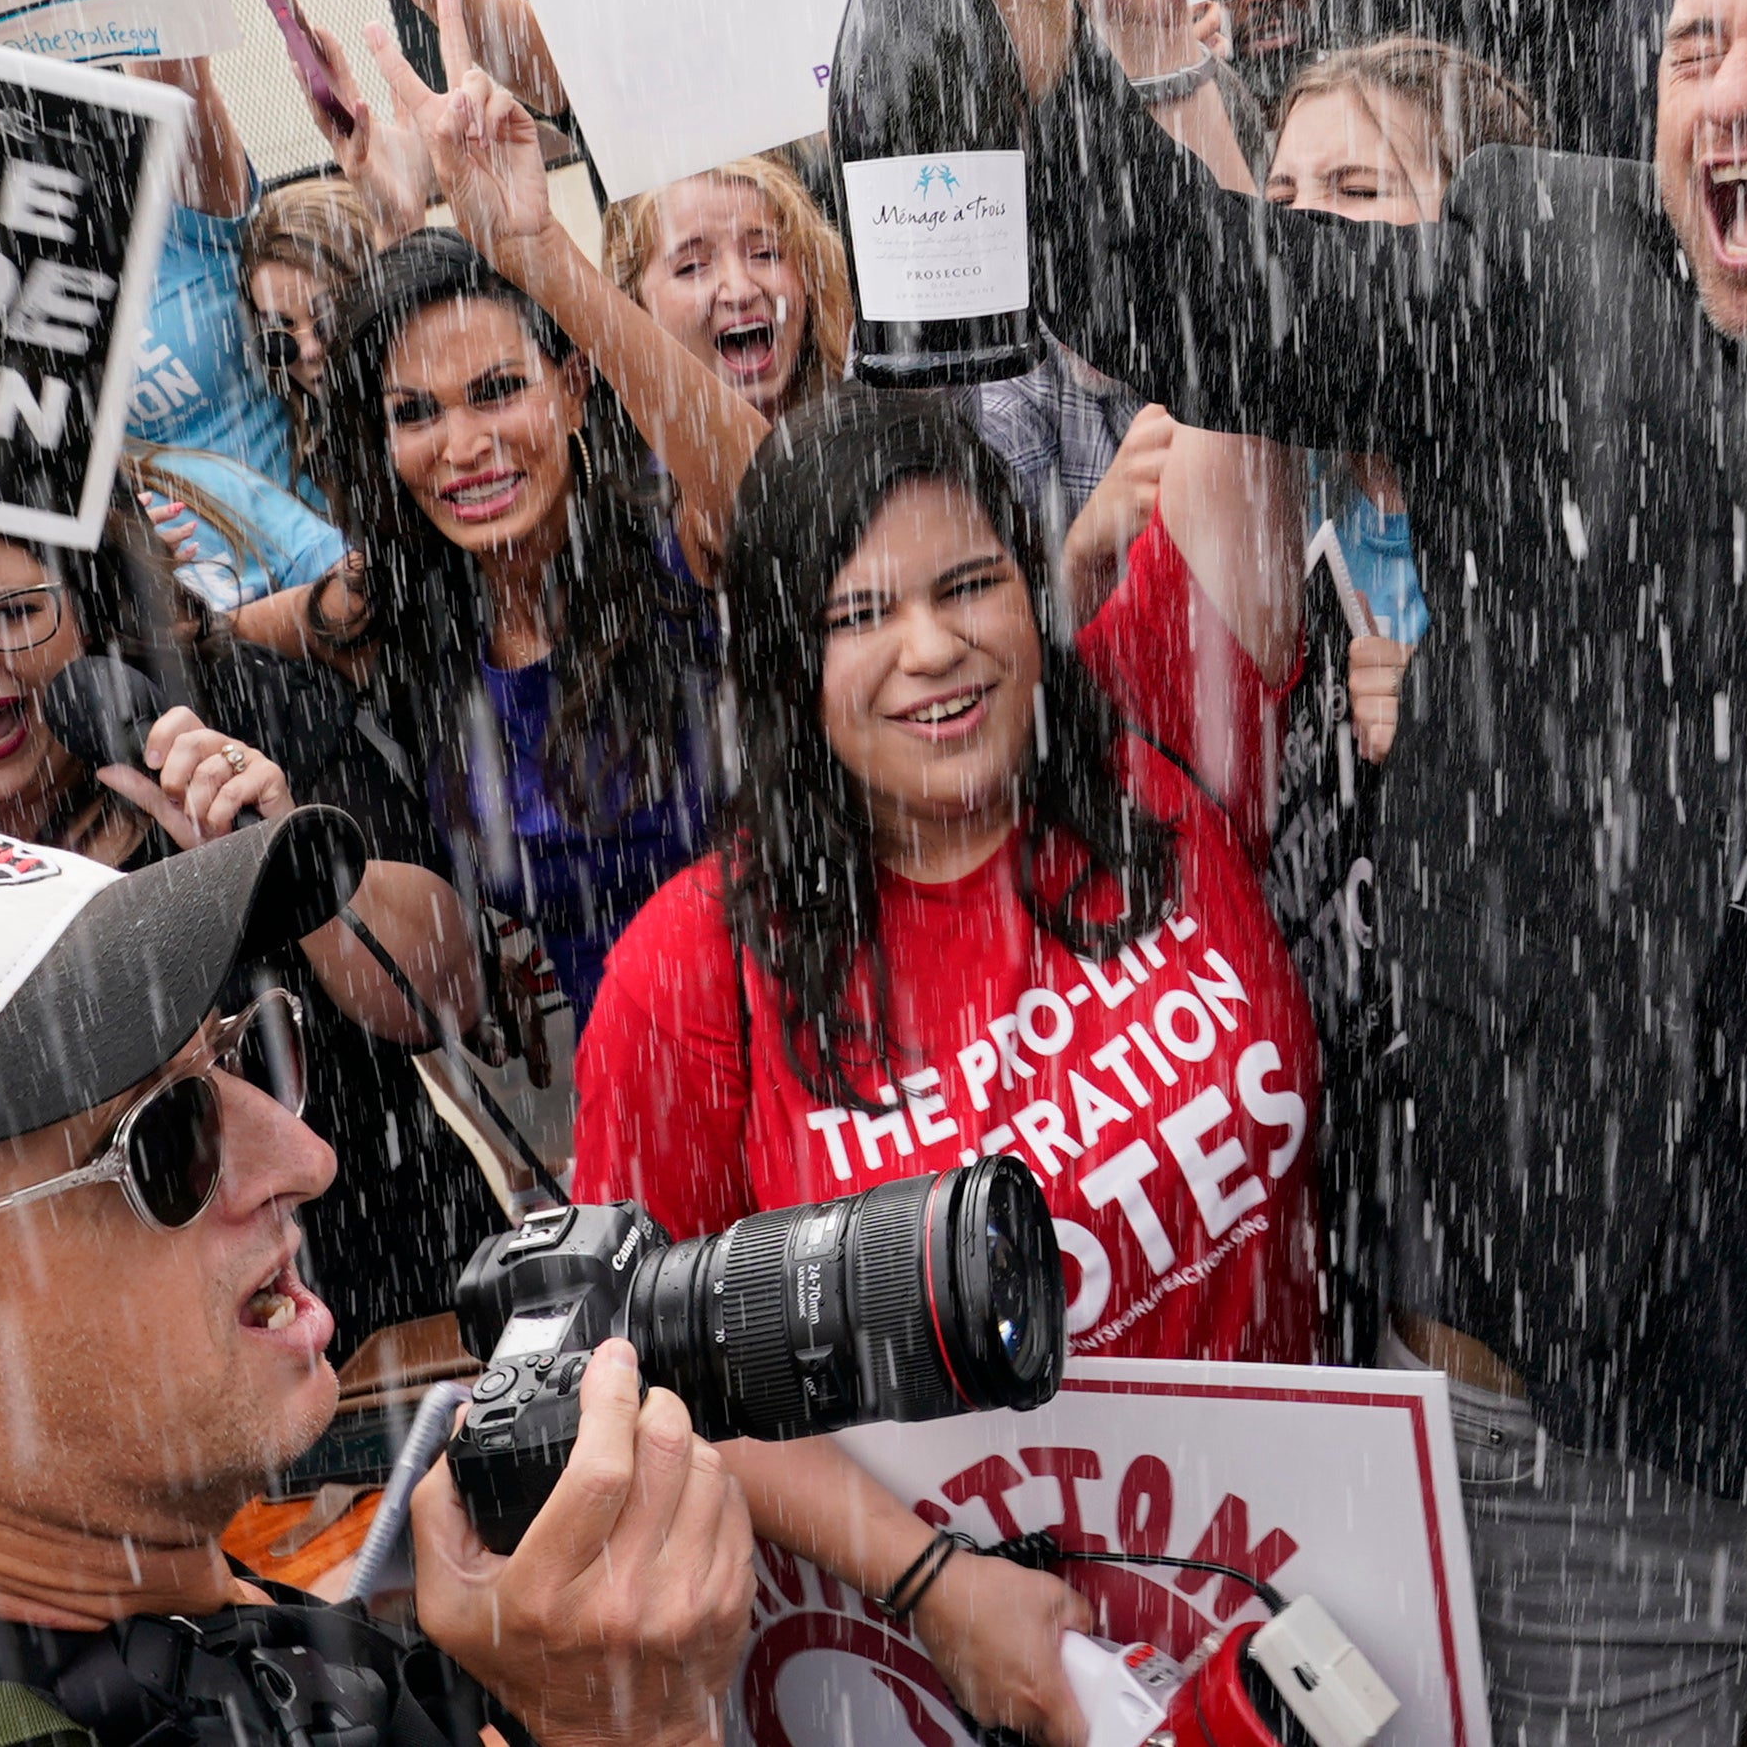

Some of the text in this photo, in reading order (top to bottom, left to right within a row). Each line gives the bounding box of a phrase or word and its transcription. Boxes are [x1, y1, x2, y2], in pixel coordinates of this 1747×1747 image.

[873, 204, 949, 232] Ménage
[966, 195, 1007, 221] Trois
[906, 265, 983, 282] PROSECCO
[806, 1066, 959, 1182] THE
[1052, 1040, 1308, 1334] OTES
[611, 1224, 642, 1272] Canon
[713, 1279, 726, 1295] 50
[797, 1265, 808, 1320] ULTRASONIC
[807, 1262, 823, 1327] 24-70mm
[714, 1327, 727, 1344] 70
[804, 1376, 818, 1398] LOCK
